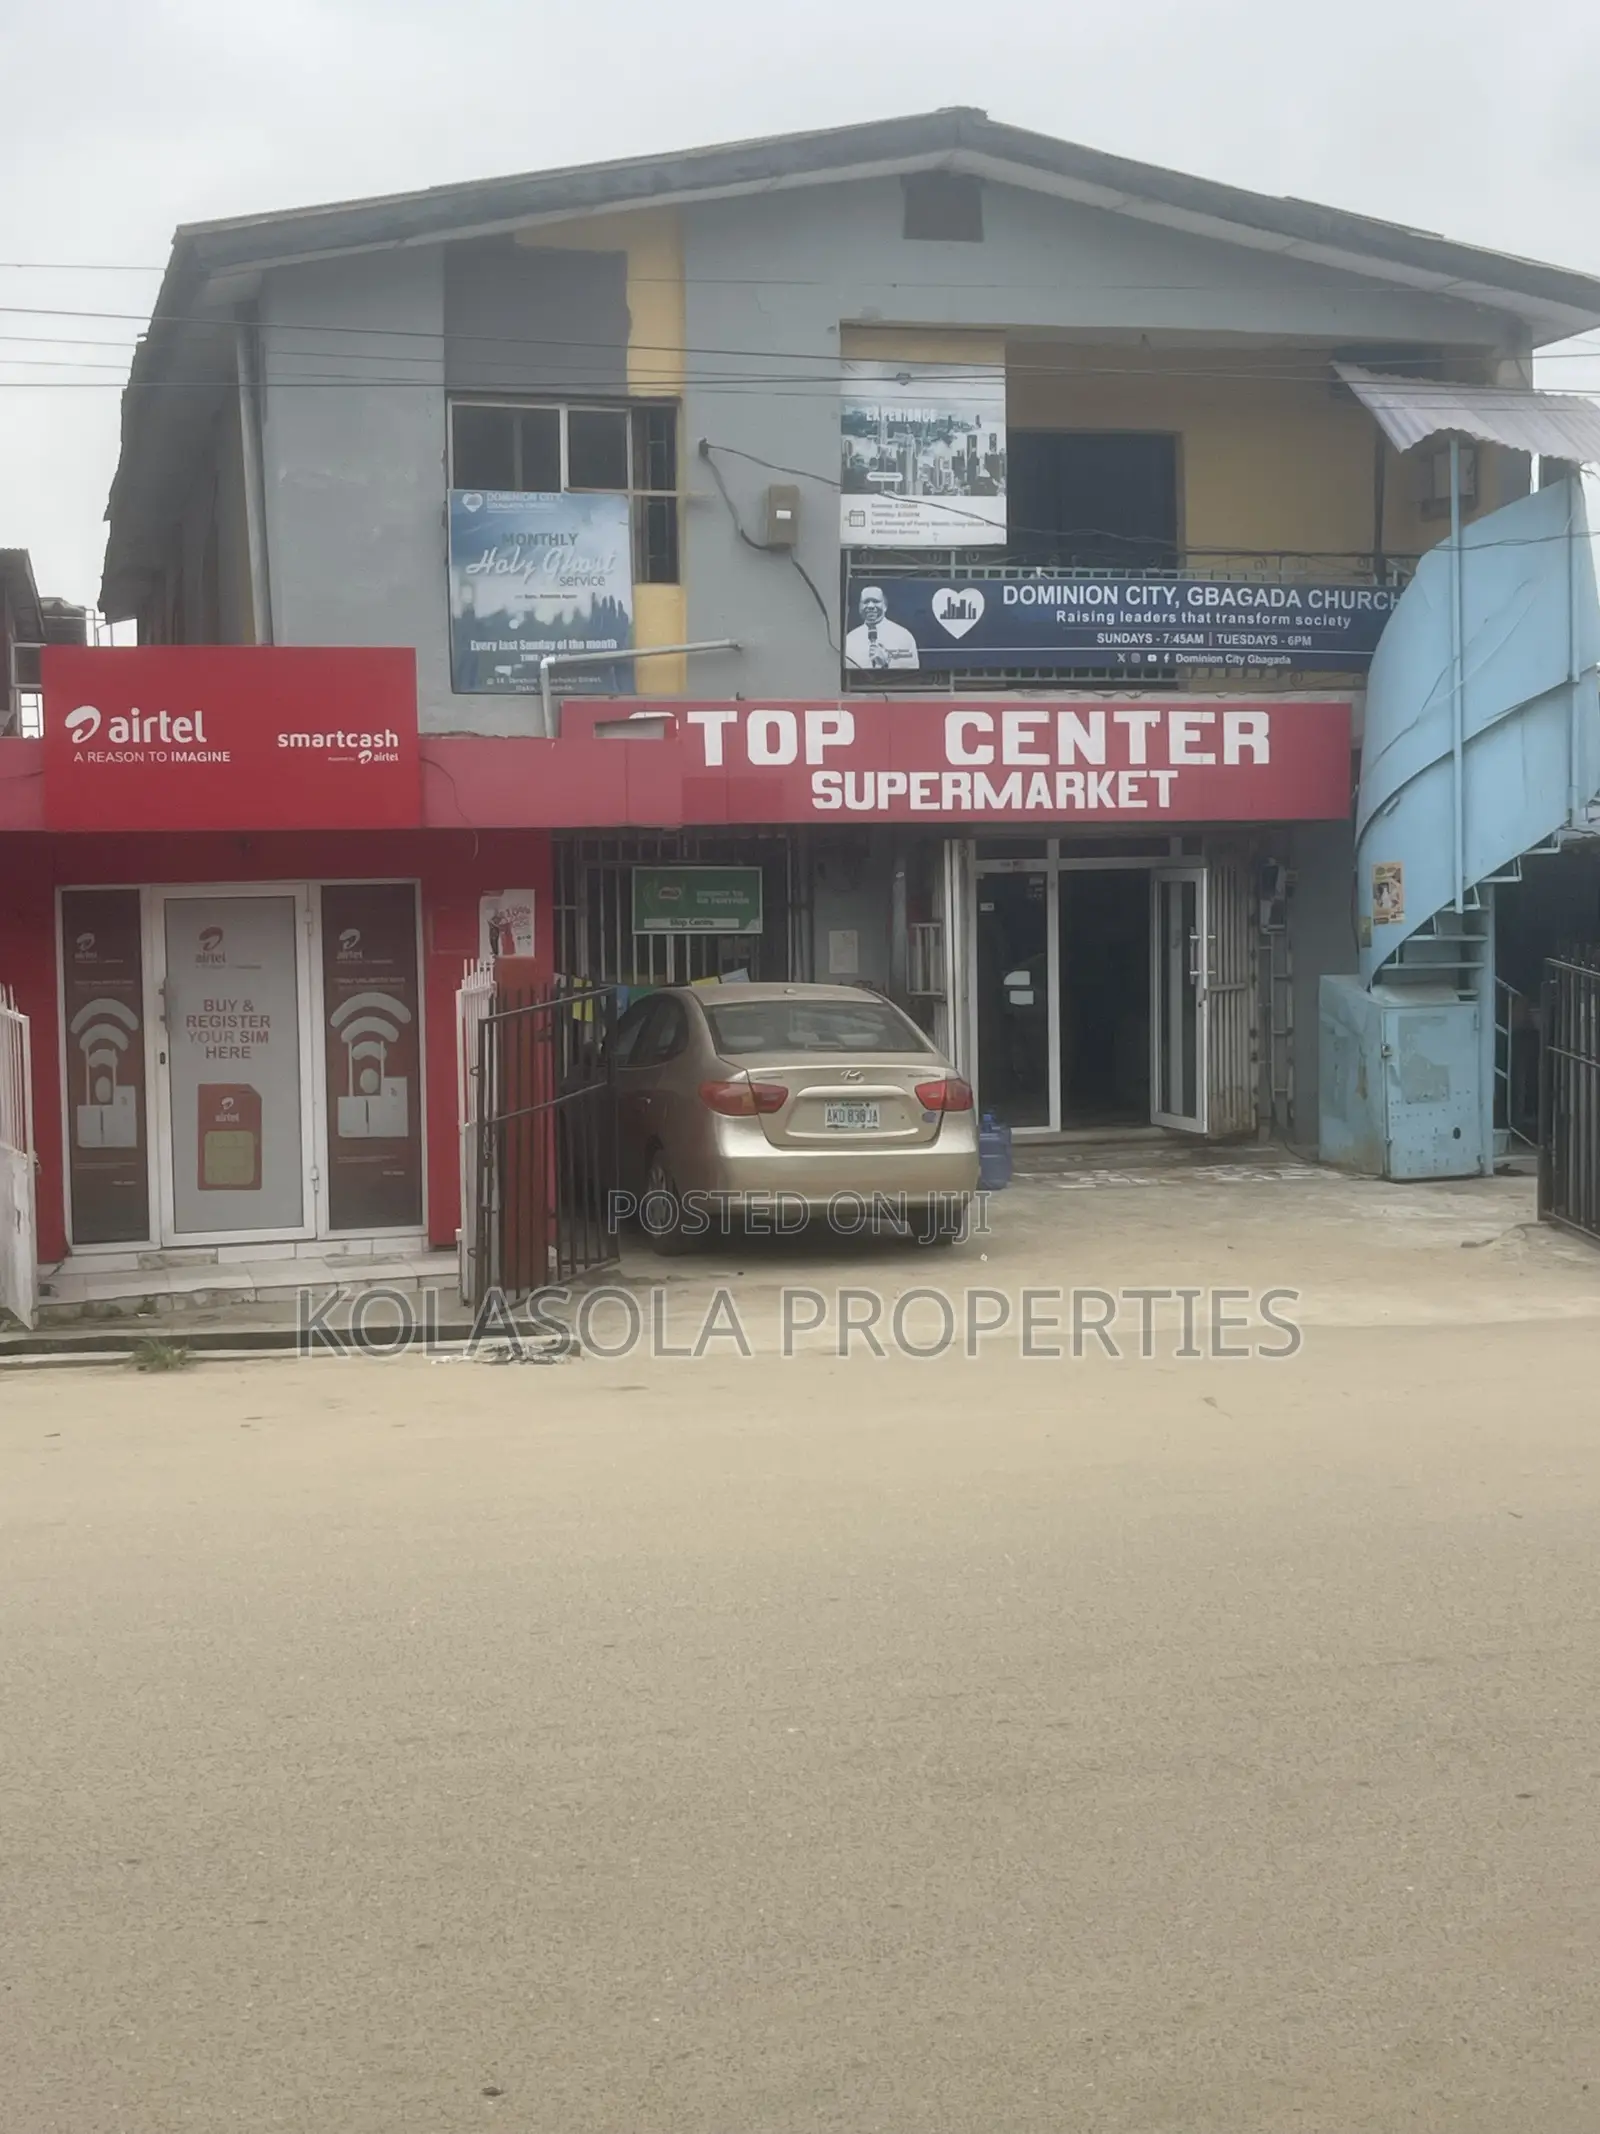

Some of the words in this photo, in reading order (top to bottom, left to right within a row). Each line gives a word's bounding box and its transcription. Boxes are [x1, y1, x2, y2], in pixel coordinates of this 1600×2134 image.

[502, 533, 579, 546] MONTHLY
[465, 546, 537, 584] Holy
[543, 547, 618, 579] Ghost
[559, 575, 605, 586] service
[1003, 584, 1118, 605] DOMINION
[1125, 585, 1180, 608] CITY,
[1187, 587, 1302, 608] GBAGADA
[1056, 610, 1115, 625] Raising
[1120, 611, 1176, 623] leaders
[1181, 611, 1211, 624] that
[1216, 612, 1290, 625] transform
[1295, 614, 1351, 629] society
[470, 640, 497, 651] Every
[520, 639, 555, 651] Sunday
[586, 638, 618, 650] month
[1097, 633, 1153, 644] SUNDAYS
[1163, 633, 1204, 645] 7:45AM
[1217, 634, 1278, 646] TUESDAYS
[1287, 636, 1312, 646] 6PM
[1175, 653, 1223, 664] Dominion
[1226, 654, 1244, 666] City
[1247, 654, 1291, 666] Gbagada
[108, 707, 208, 743] airtel
[277, 729, 399, 748] smartcash
[628, 709, 856, 766] TOP
[944, 711, 1270, 765] CENTER
[74, 752, 84, 762] A
[88, 752, 144, 763] REASON
[148, 752, 167, 762] TO
[171, 752, 231, 762] IMAGINE
[374, 752, 399, 762] airtel
[812, 770, 1179, 810] SUPERMARKET
[203, 999, 238, 1013] BUY
[242, 999, 254, 1013] &
[186, 1015, 270, 1028] REGISTER
[188, 1031, 235, 1044] YOUR
[240, 1031, 269, 1044] SIM
[206, 1046, 252, 1059] HERE
